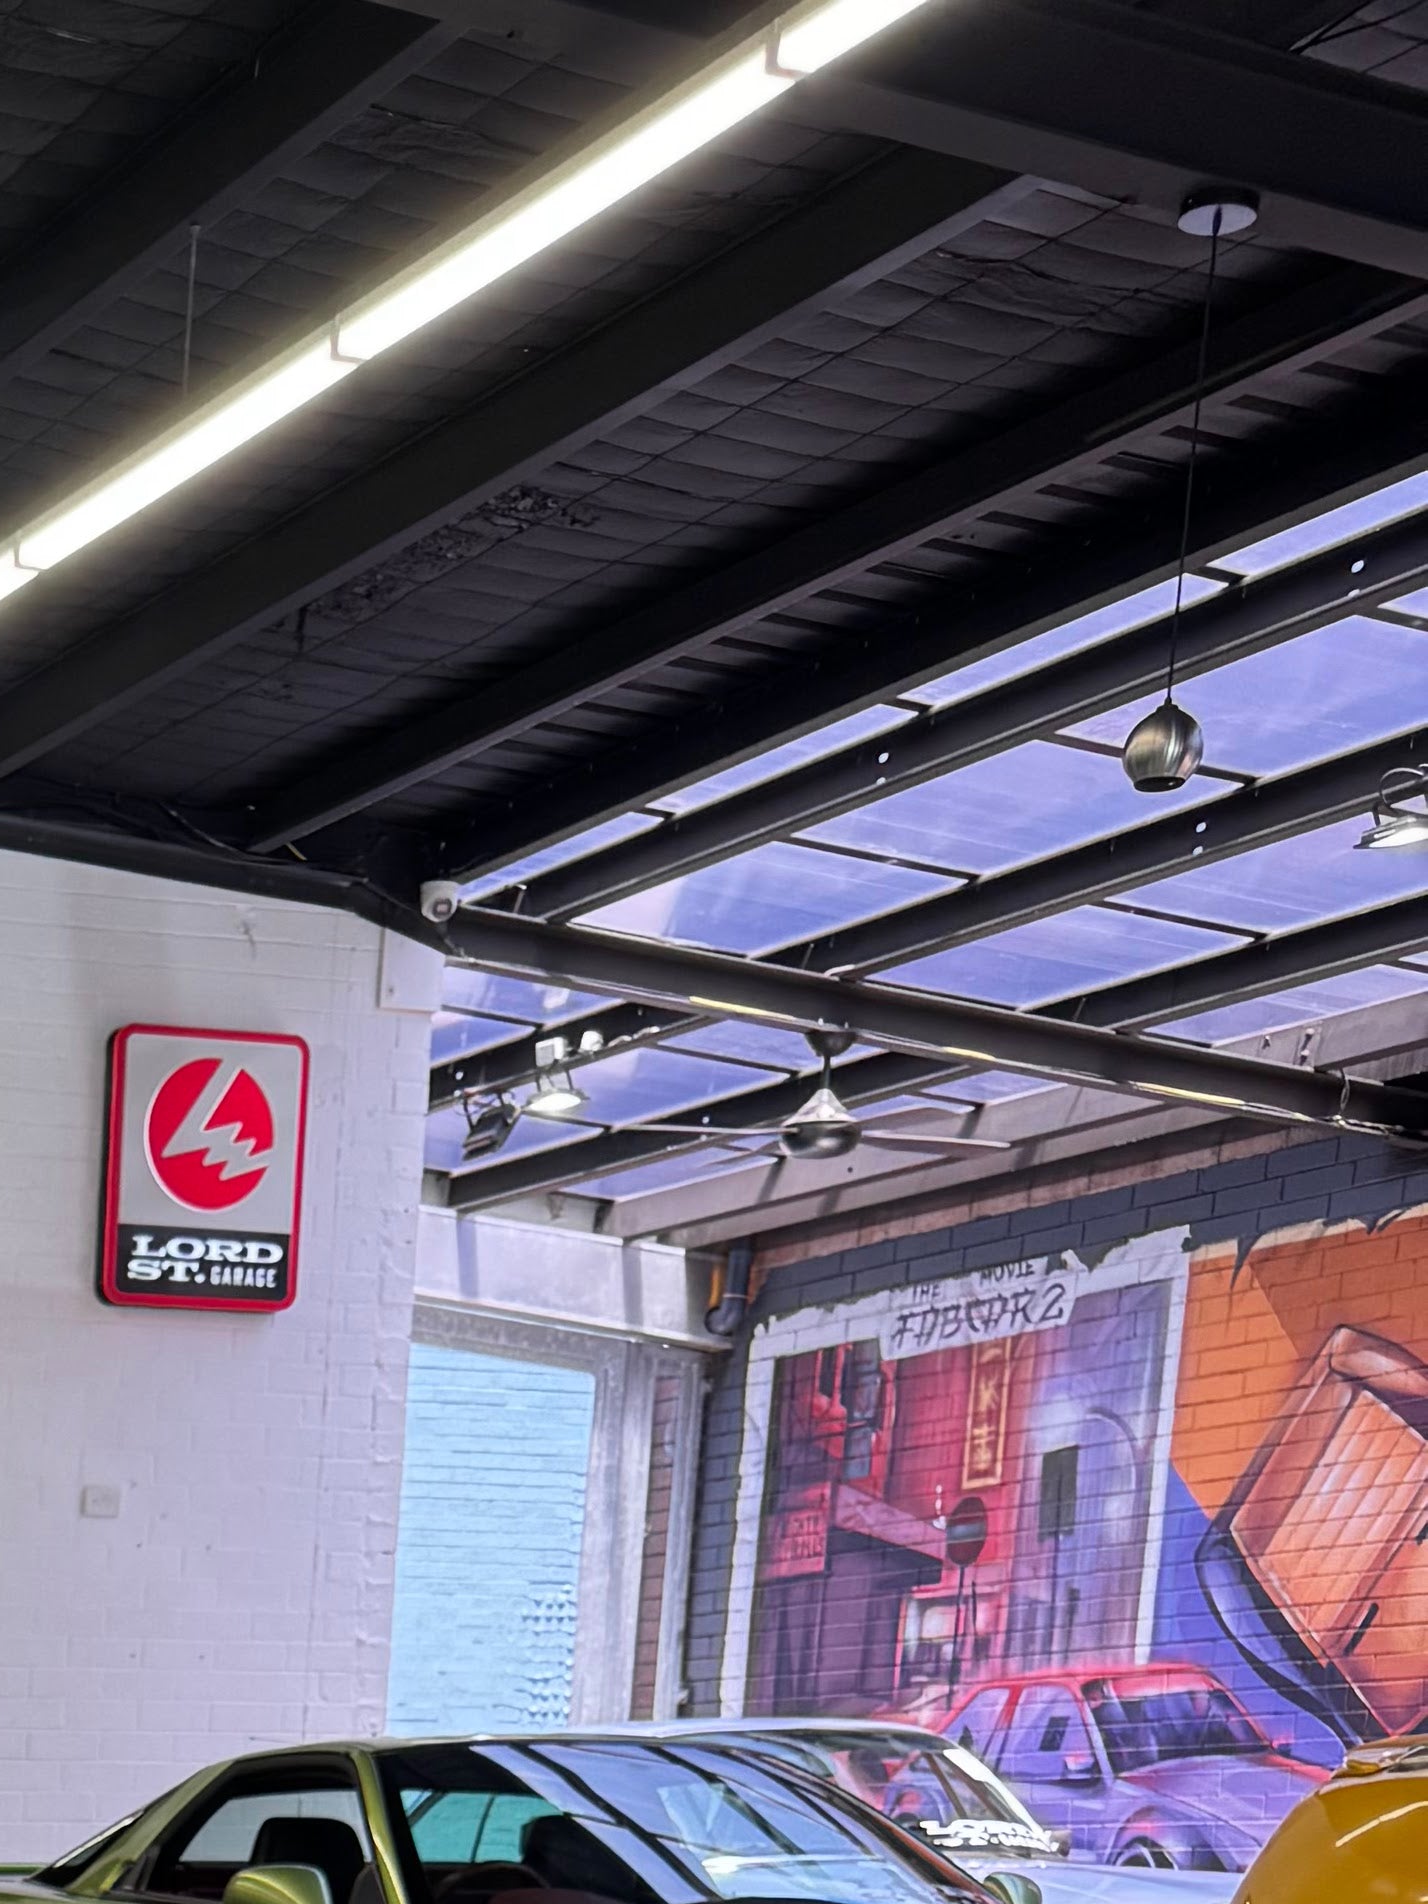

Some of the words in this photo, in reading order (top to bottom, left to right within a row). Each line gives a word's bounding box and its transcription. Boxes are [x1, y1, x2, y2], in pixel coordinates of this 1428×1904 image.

[132, 1234, 284, 1264] LORD
[127, 1259, 206, 1284] ST.
[210, 1265, 278, 1289] GARAGE
